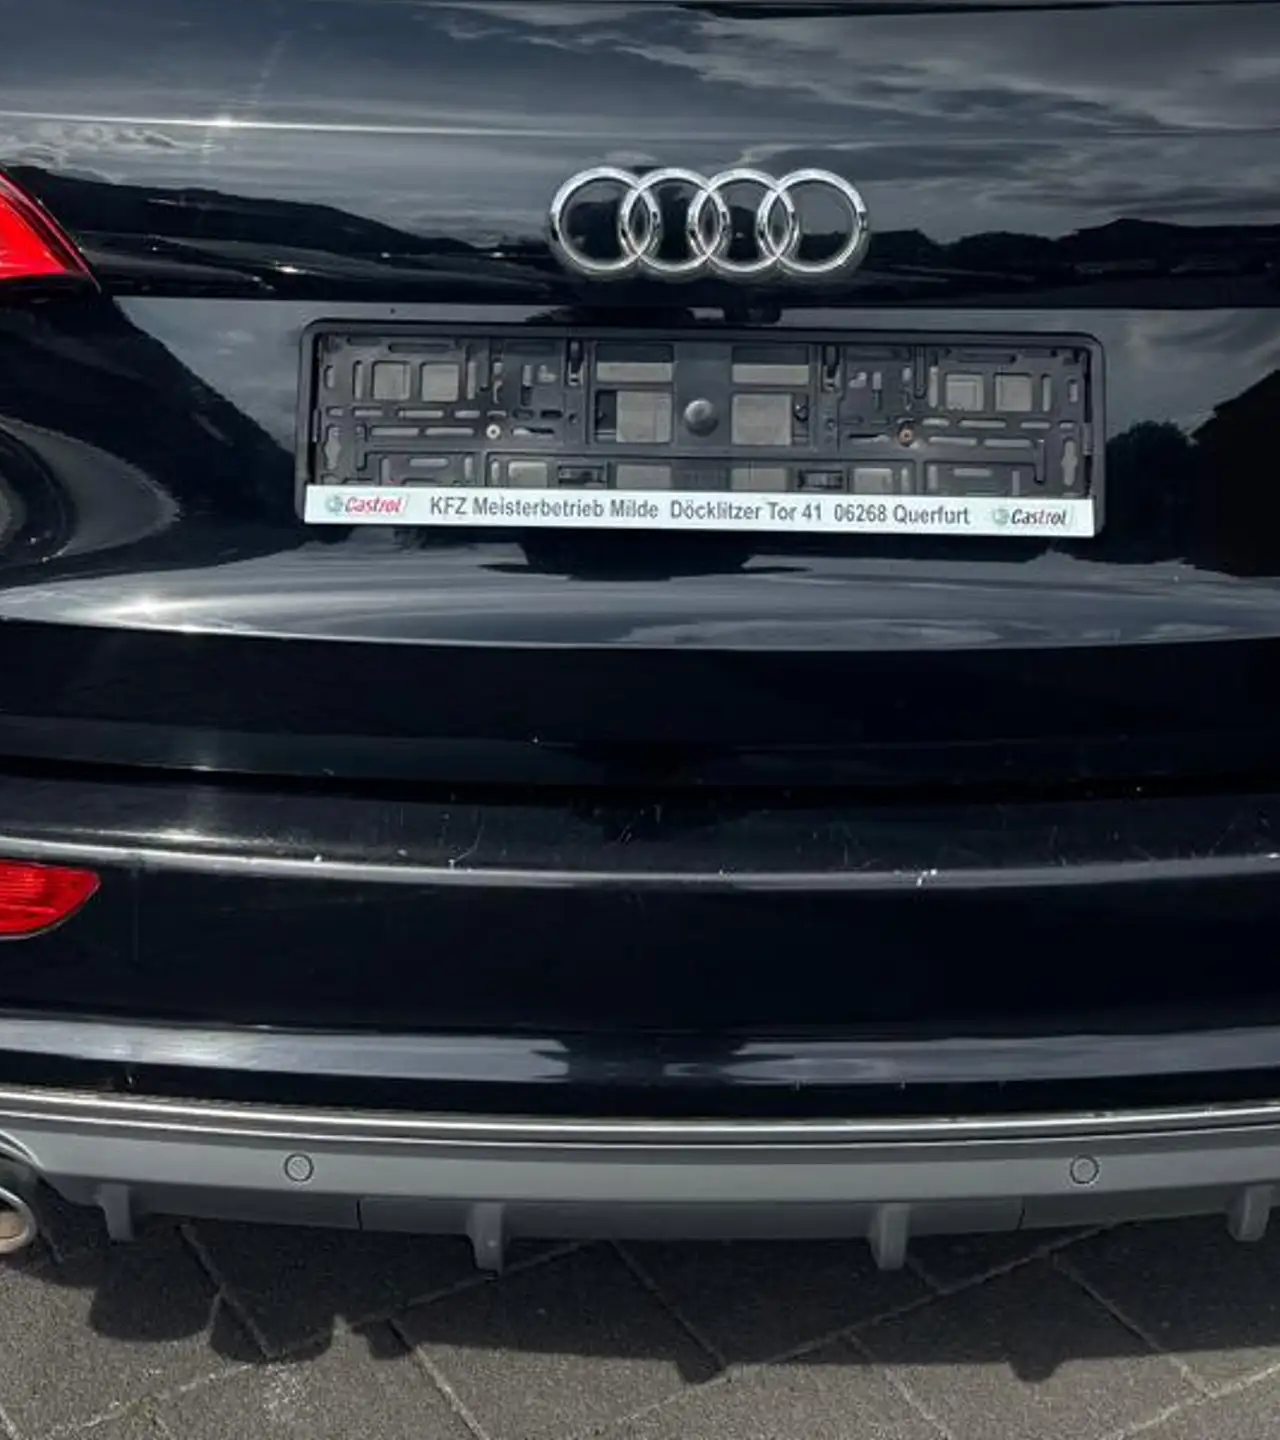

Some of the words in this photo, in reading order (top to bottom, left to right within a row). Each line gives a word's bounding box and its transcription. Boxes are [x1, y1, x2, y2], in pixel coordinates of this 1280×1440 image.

[344, 496, 401, 513] Castrol
[430, 497, 468, 516] KFZ
[473, 496, 605, 518] Meisterbetrieb
[610, 498, 659, 519] Milde
[670, 498, 761, 522] Döcklitzer
[767, 502, 797, 522] Tor
[802, 502, 822, 522] 41
[834, 504, 887, 523] 06268
[893, 504, 970, 527] Querfurt
[1011, 508, 1066, 526] Castrol
